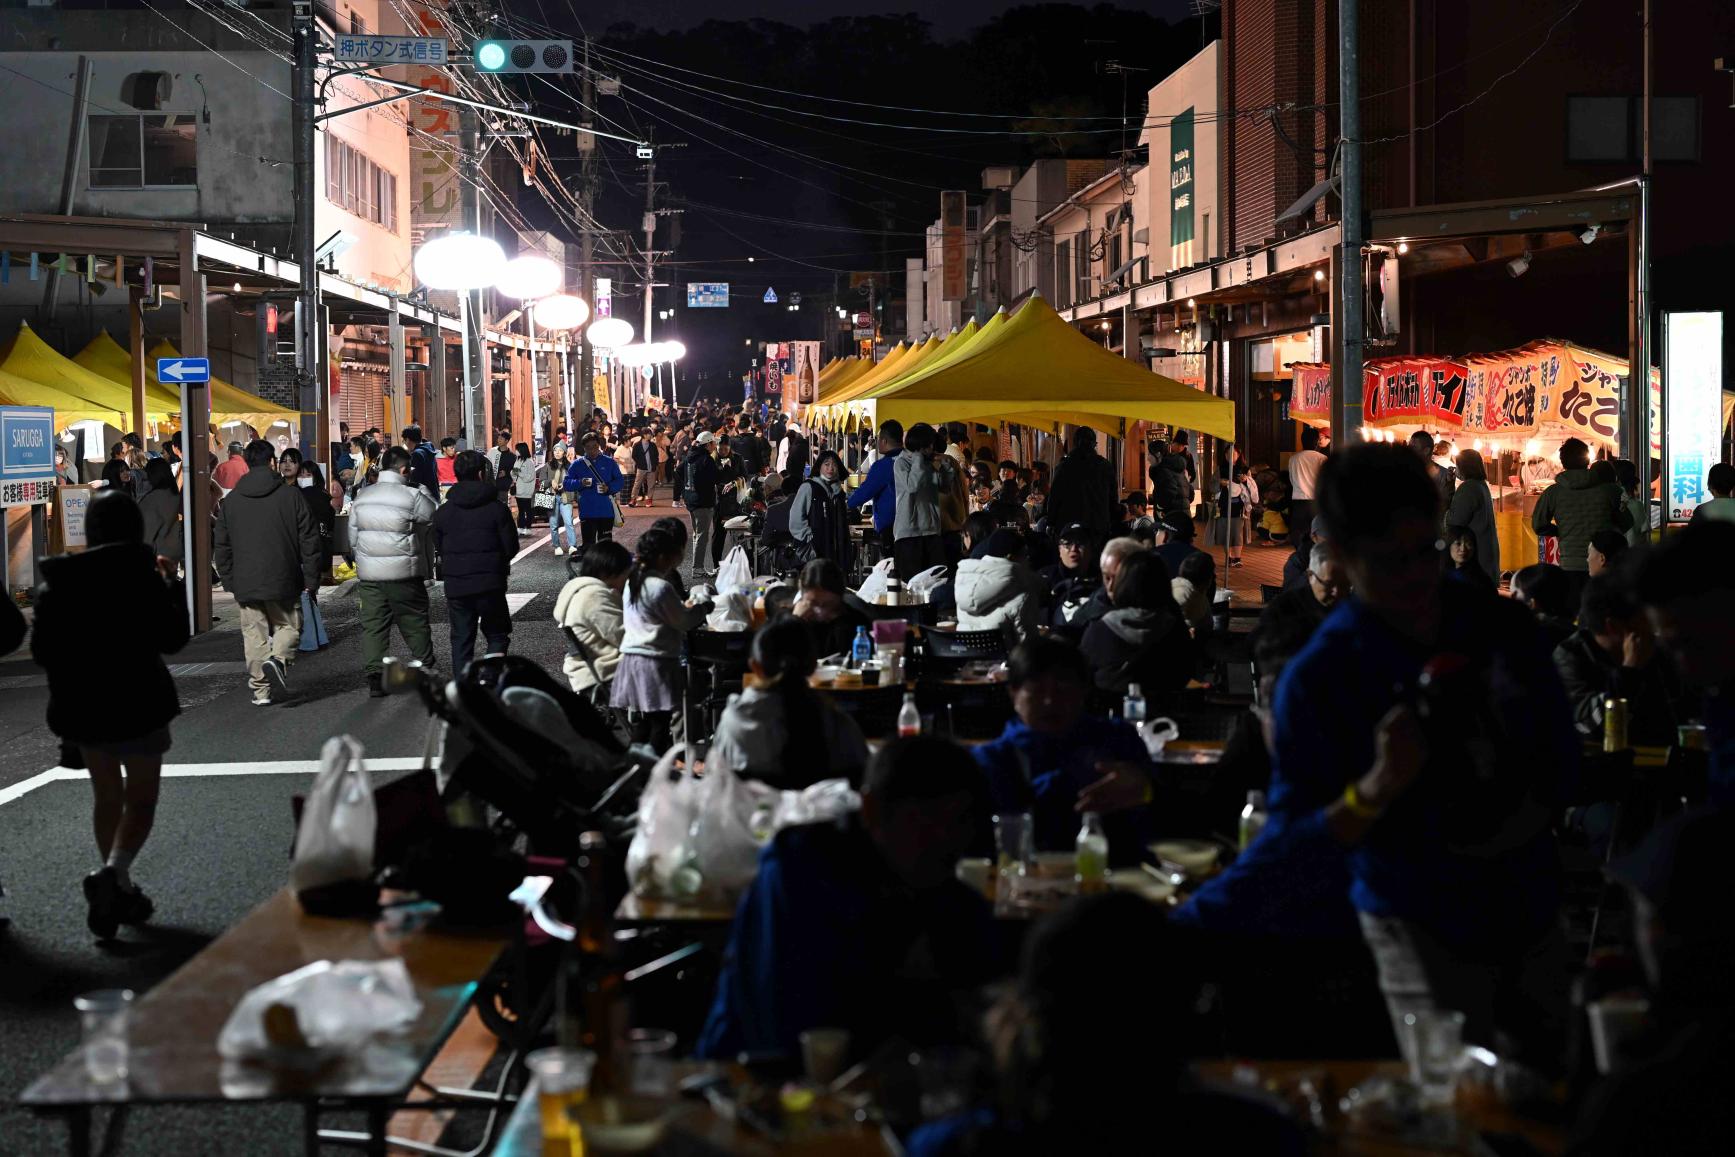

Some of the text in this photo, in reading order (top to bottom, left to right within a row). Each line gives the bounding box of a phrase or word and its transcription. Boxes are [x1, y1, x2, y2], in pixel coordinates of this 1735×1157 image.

[340, 39, 442, 60] 押ボタン式信号
[768, 361, 779, 391] 焼いも
[1502, 382, 1536, 427] たこ焼
[1560, 380, 1620, 443] たこ
[12, 428, 44, 448] SARUGGA
[1673, 454, 1704, 504] 歯科
[1681, 509, 1693, 518] 42
